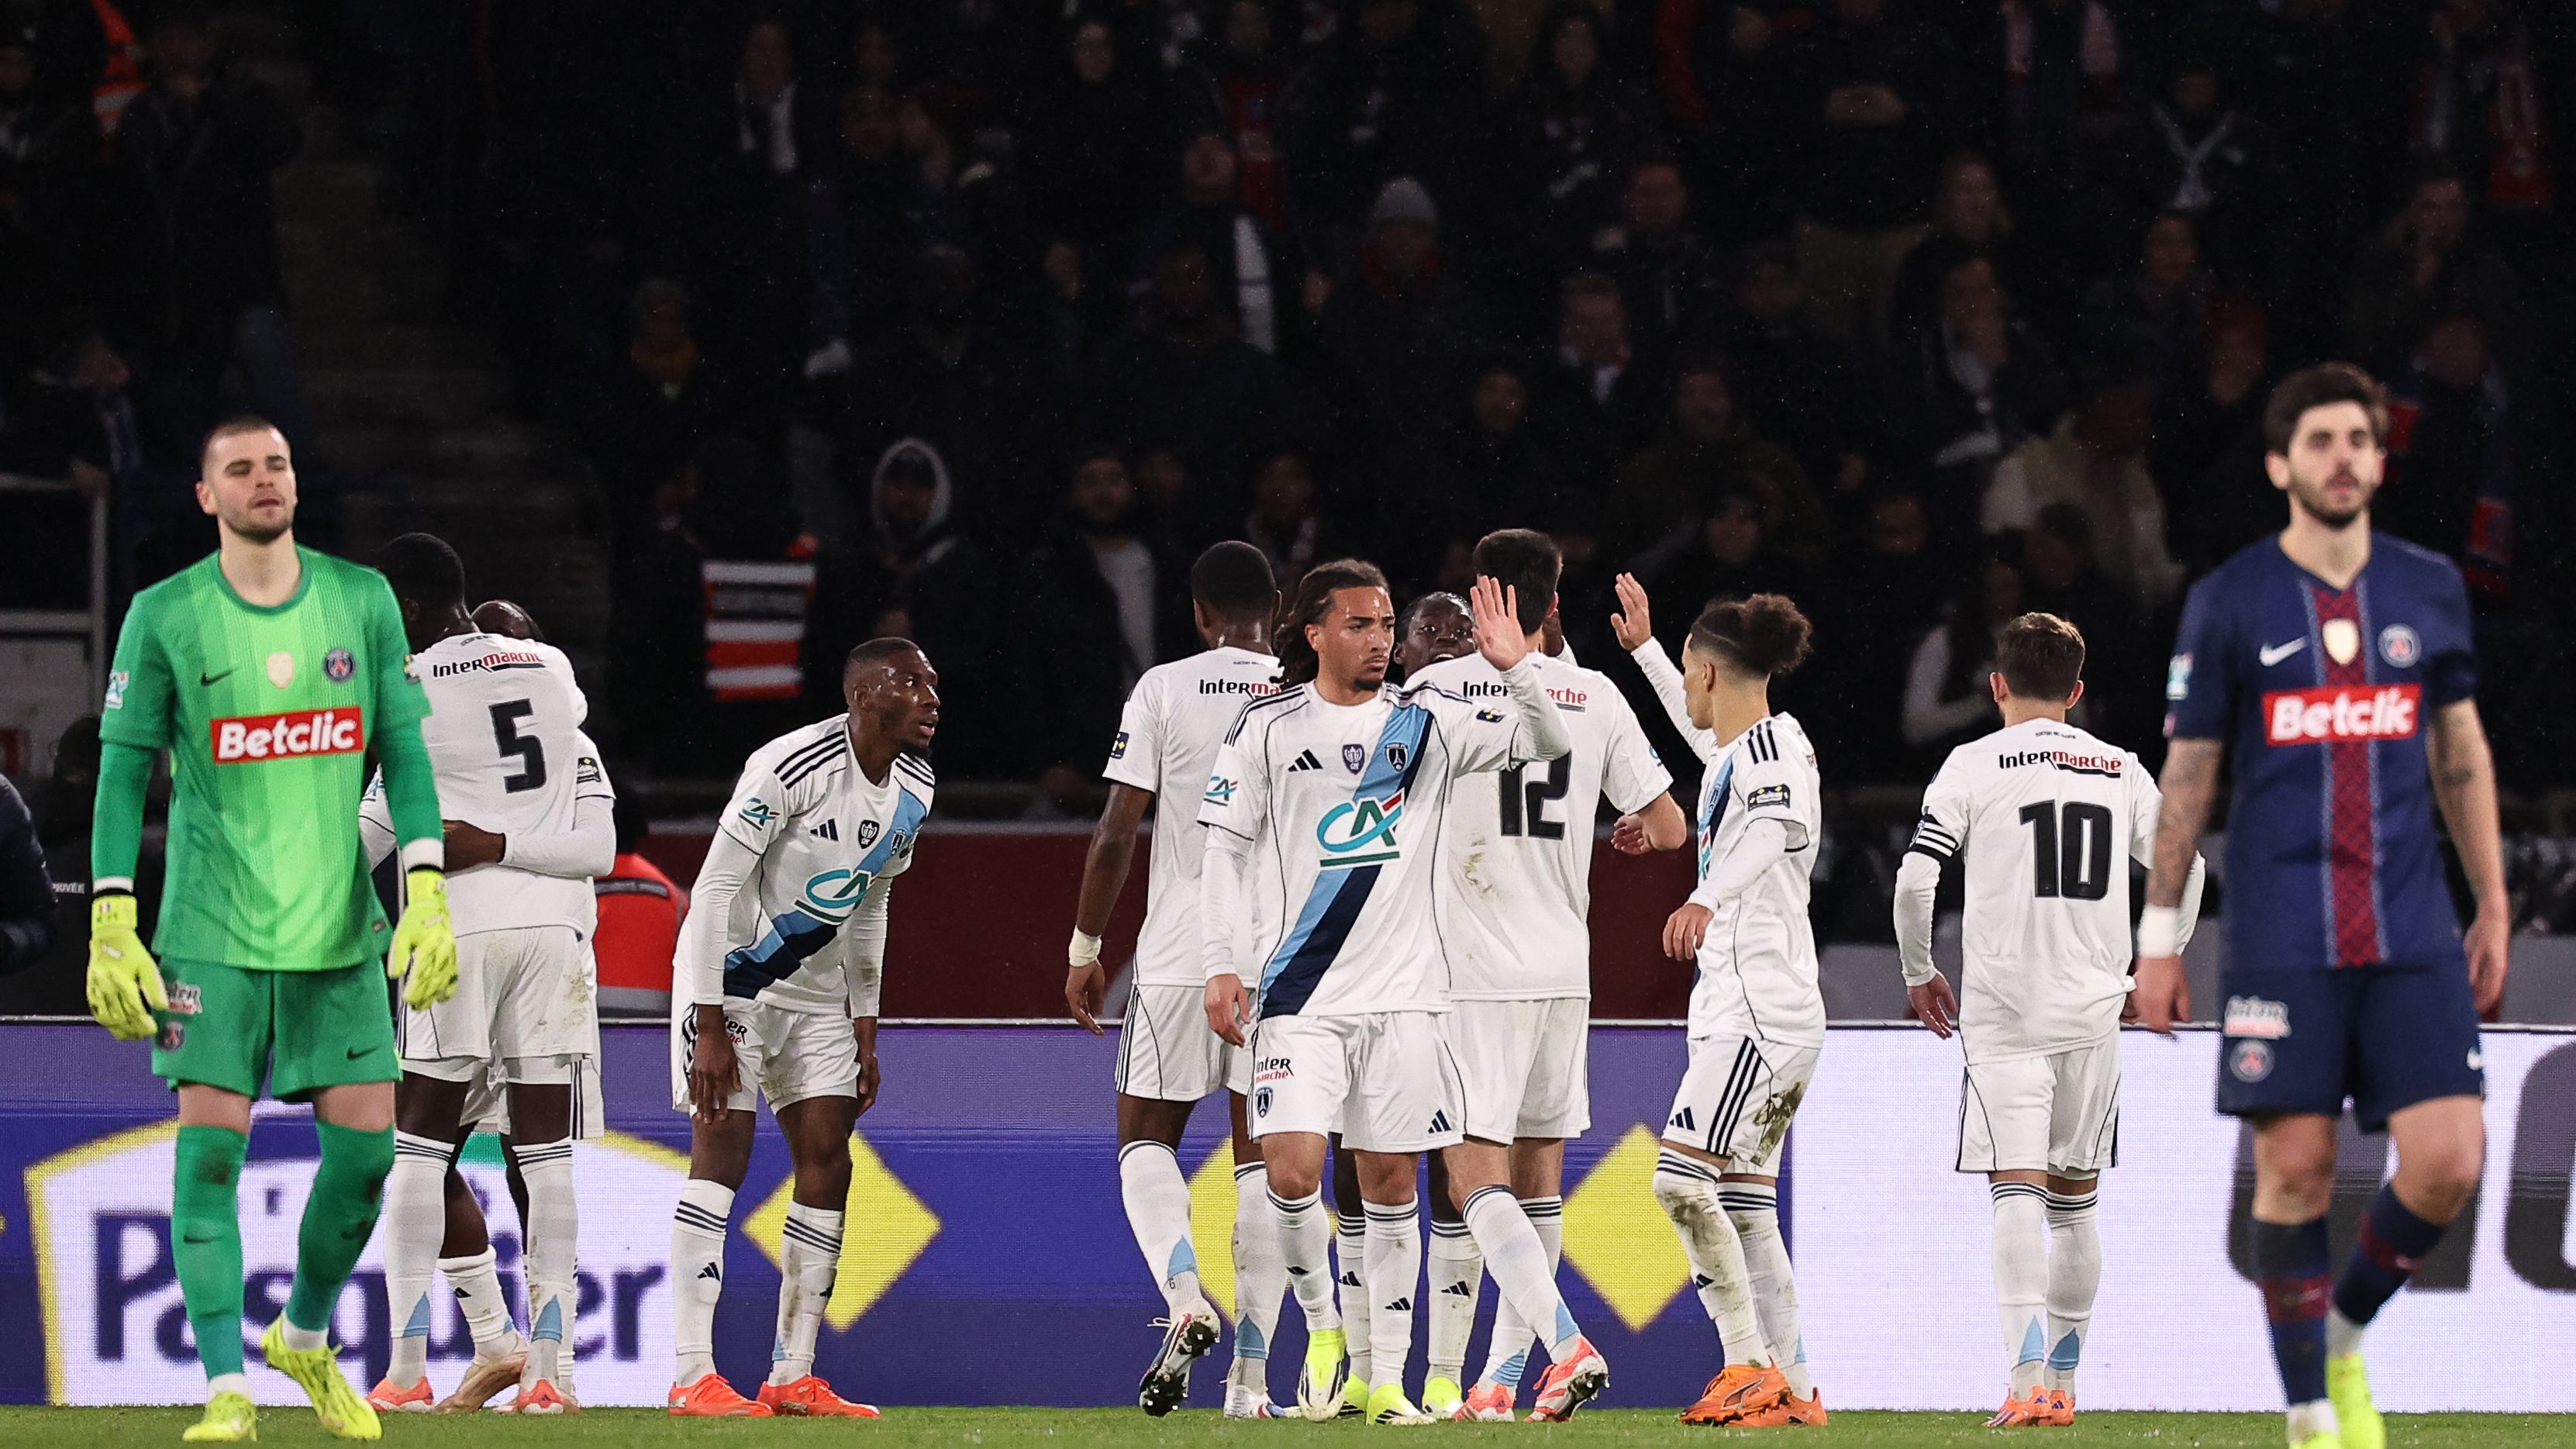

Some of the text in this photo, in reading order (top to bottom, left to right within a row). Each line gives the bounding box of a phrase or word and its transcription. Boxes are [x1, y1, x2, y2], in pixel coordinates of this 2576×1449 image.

[1199, 678, 1282, 700] Interma
[2271, 687, 2414, 740] Betclic
[218, 710, 357, 760] Betclic
[488, 698, 547, 794] 5
[1499, 749, 1571, 840] 12
[2019, 799, 2112, 901] 10
